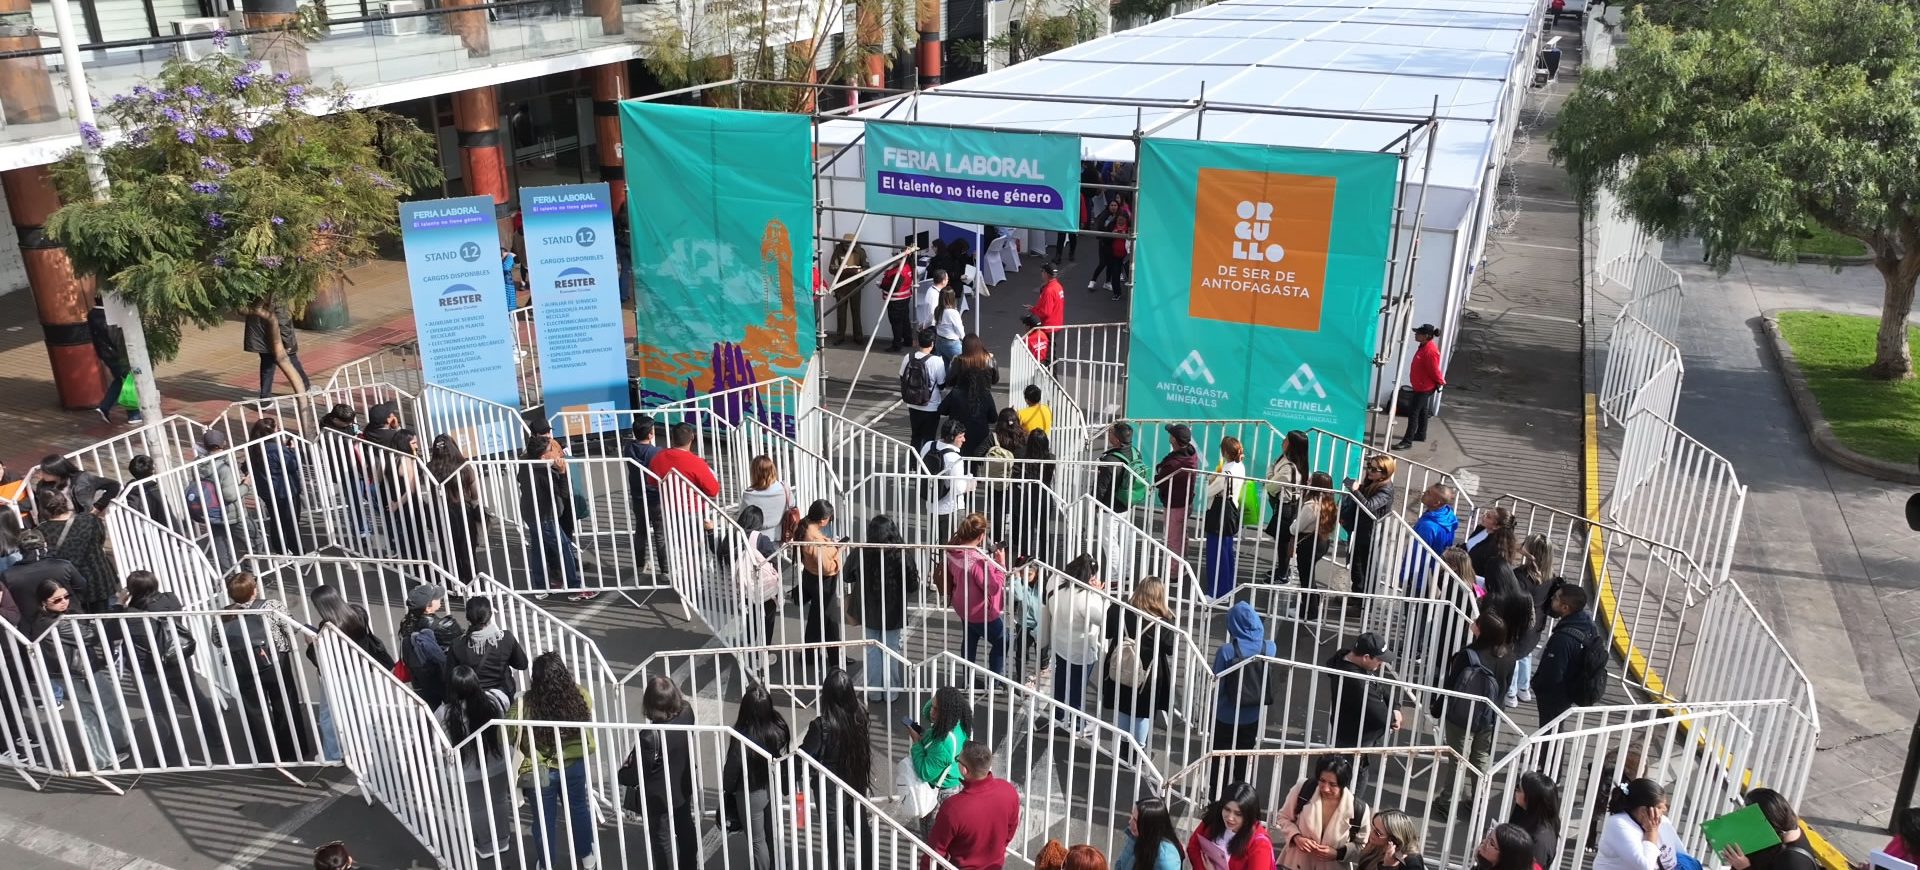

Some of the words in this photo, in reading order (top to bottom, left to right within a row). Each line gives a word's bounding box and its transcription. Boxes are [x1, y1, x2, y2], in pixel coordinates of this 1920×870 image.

[883, 146, 940, 172] FERIA
[945, 153, 1045, 180] LABORAL
[882, 176, 895, 190] El
[898, 178, 943, 195] talento
[947, 186, 962, 197] no
[966, 185, 1000, 200] tiene
[1003, 188, 1051, 204] género
[533, 196, 557, 204] FERIA
[558, 193, 595, 202] LABORAL
[413, 210, 439, 219] FERIA
[440, 206, 480, 217] LABORAL
[1236, 200, 1274, 221] OR
[542, 235, 573, 246] STAND
[578, 231, 594, 243] 12
[1234, 221, 1270, 241] GU
[425, 251, 457, 262] STAND
[462, 246, 479, 259] 12
[540, 257, 565, 265] CARGOS
[566, 254, 604, 263] DISPONIBLES
[1232, 241, 1285, 263] LLO
[423, 274, 449, 283] CARGOS
[450, 269, 490, 279] DISPONIBLES
[1218, 265, 1238, 277] DE
[1242, 267, 1270, 280] SER
[1275, 271, 1296, 283] DE
[554, 278, 596, 289] RESITER
[1200, 277, 1310, 299] ANTOFAGASTA
[438, 294, 482, 307] RESITER
[1156, 382, 1229, 400] ANTOFAGASTA
[1166, 393, 1217, 408] MINERALS
[1270, 398, 1332, 413] CENTINELA
[1306, 415, 1337, 424] MINERALS
